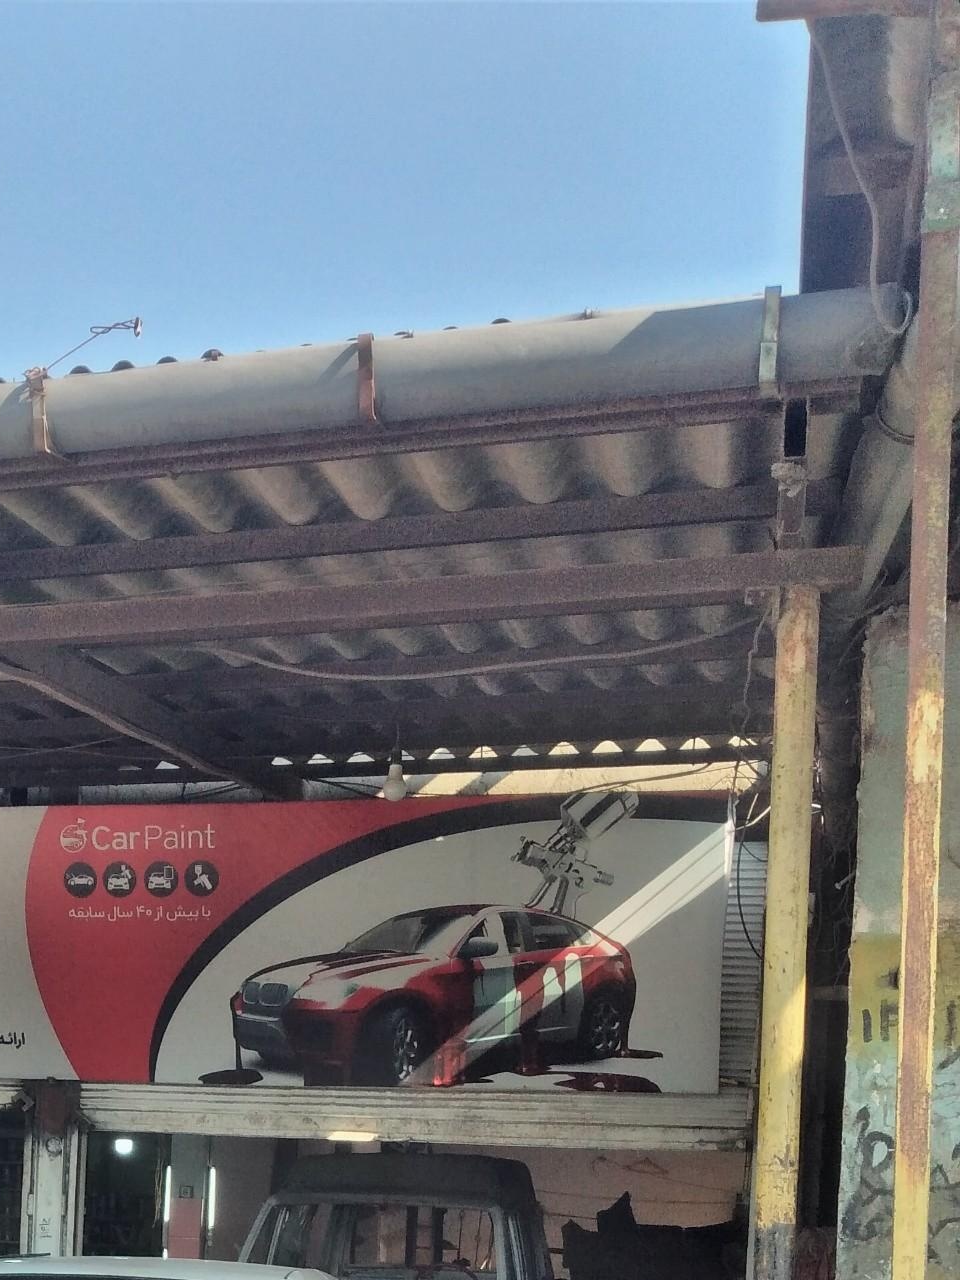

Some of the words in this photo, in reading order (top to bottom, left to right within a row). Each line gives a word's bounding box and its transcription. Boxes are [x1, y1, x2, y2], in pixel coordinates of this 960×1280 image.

[68, 905, 105, 920] سابقه
[107, 906, 133, 921] سال
[153, 905, 163, 921] از
[166, 904, 200, 921] بیش
[201, 905, 211, 920] با
